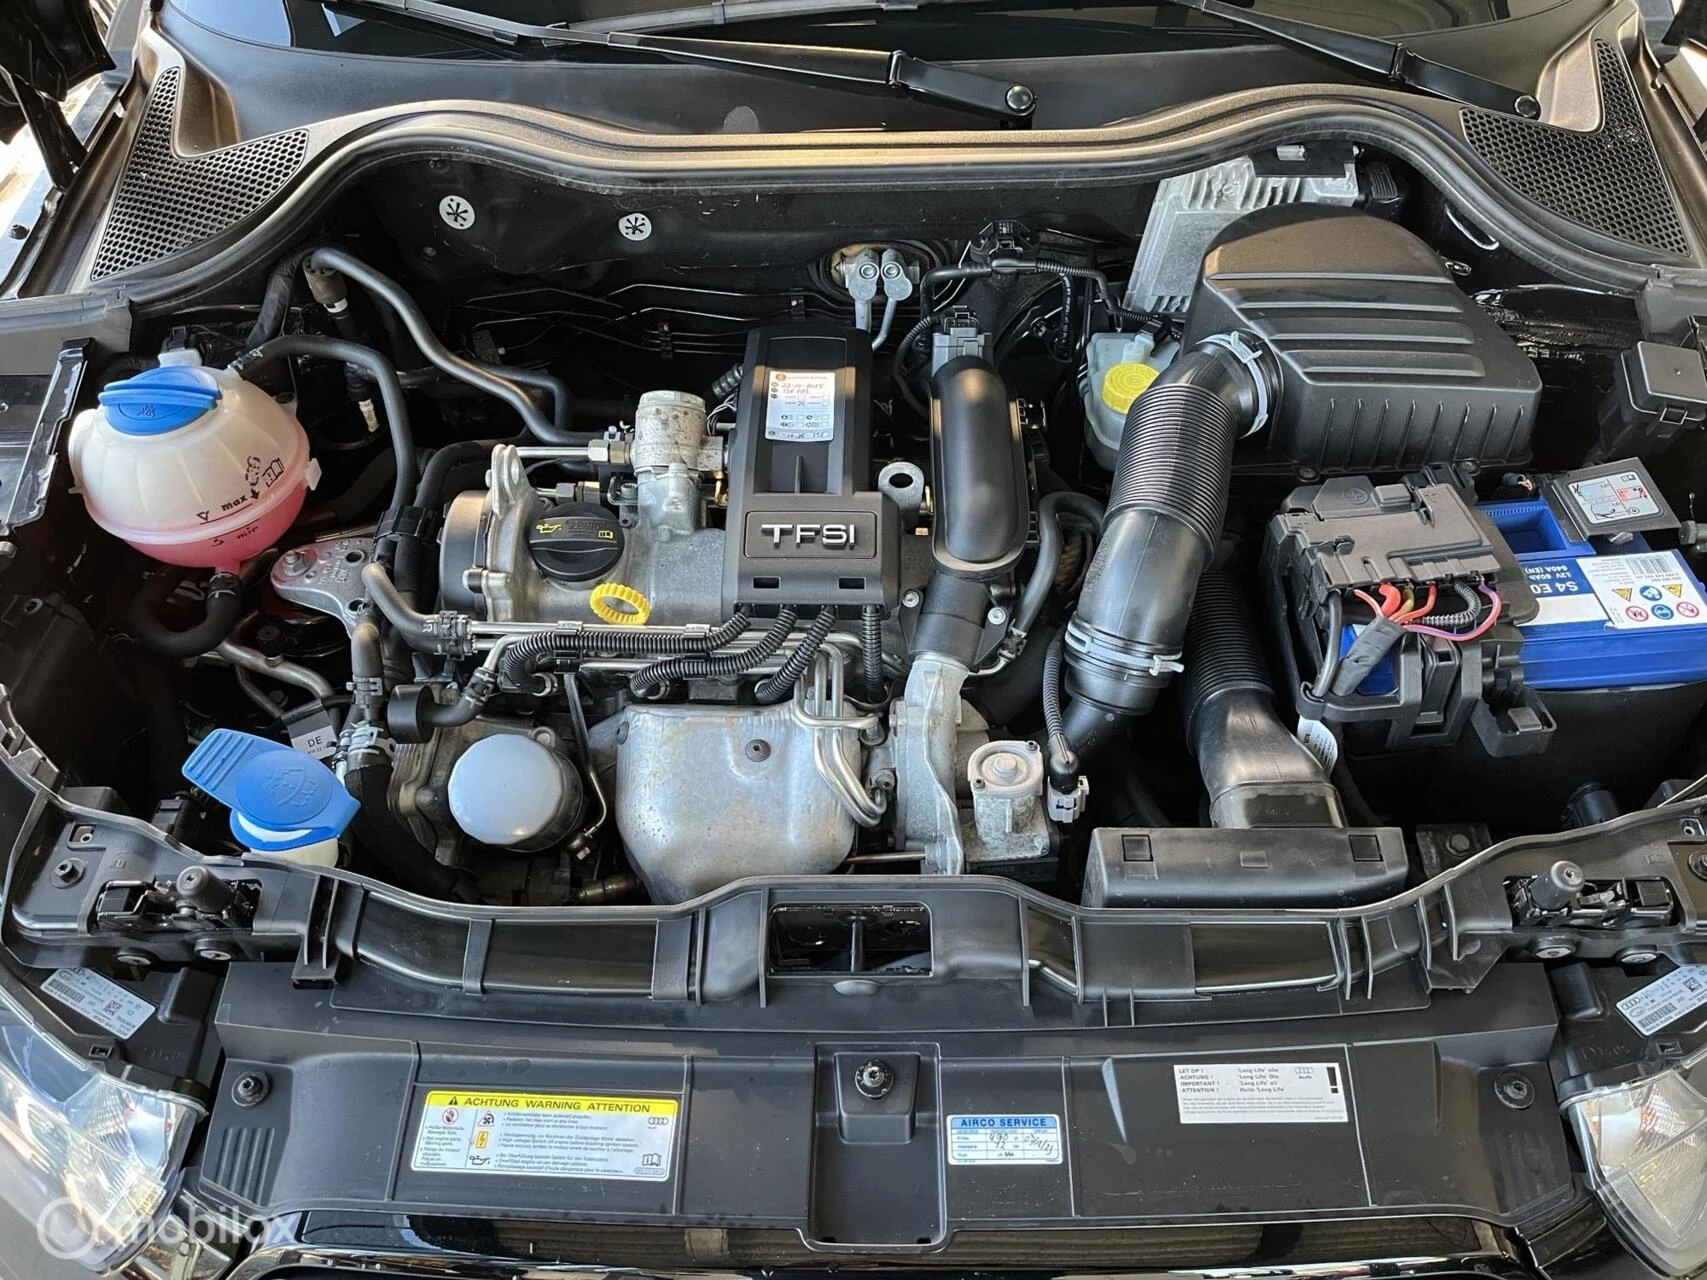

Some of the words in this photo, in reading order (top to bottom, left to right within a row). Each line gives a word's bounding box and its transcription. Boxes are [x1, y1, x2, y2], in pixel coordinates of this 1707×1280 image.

[221, 494, 248, 512] max
[761, 524, 856, 548] TFSI
[1555, 581, 1578, 592] S4
[307, 736, 323, 748] DE
[464, 1098, 519, 1108] ACHTUNG
[526, 1100, 582, 1110] WARNING
[587, 1102, 650, 1113] ATTENTION
